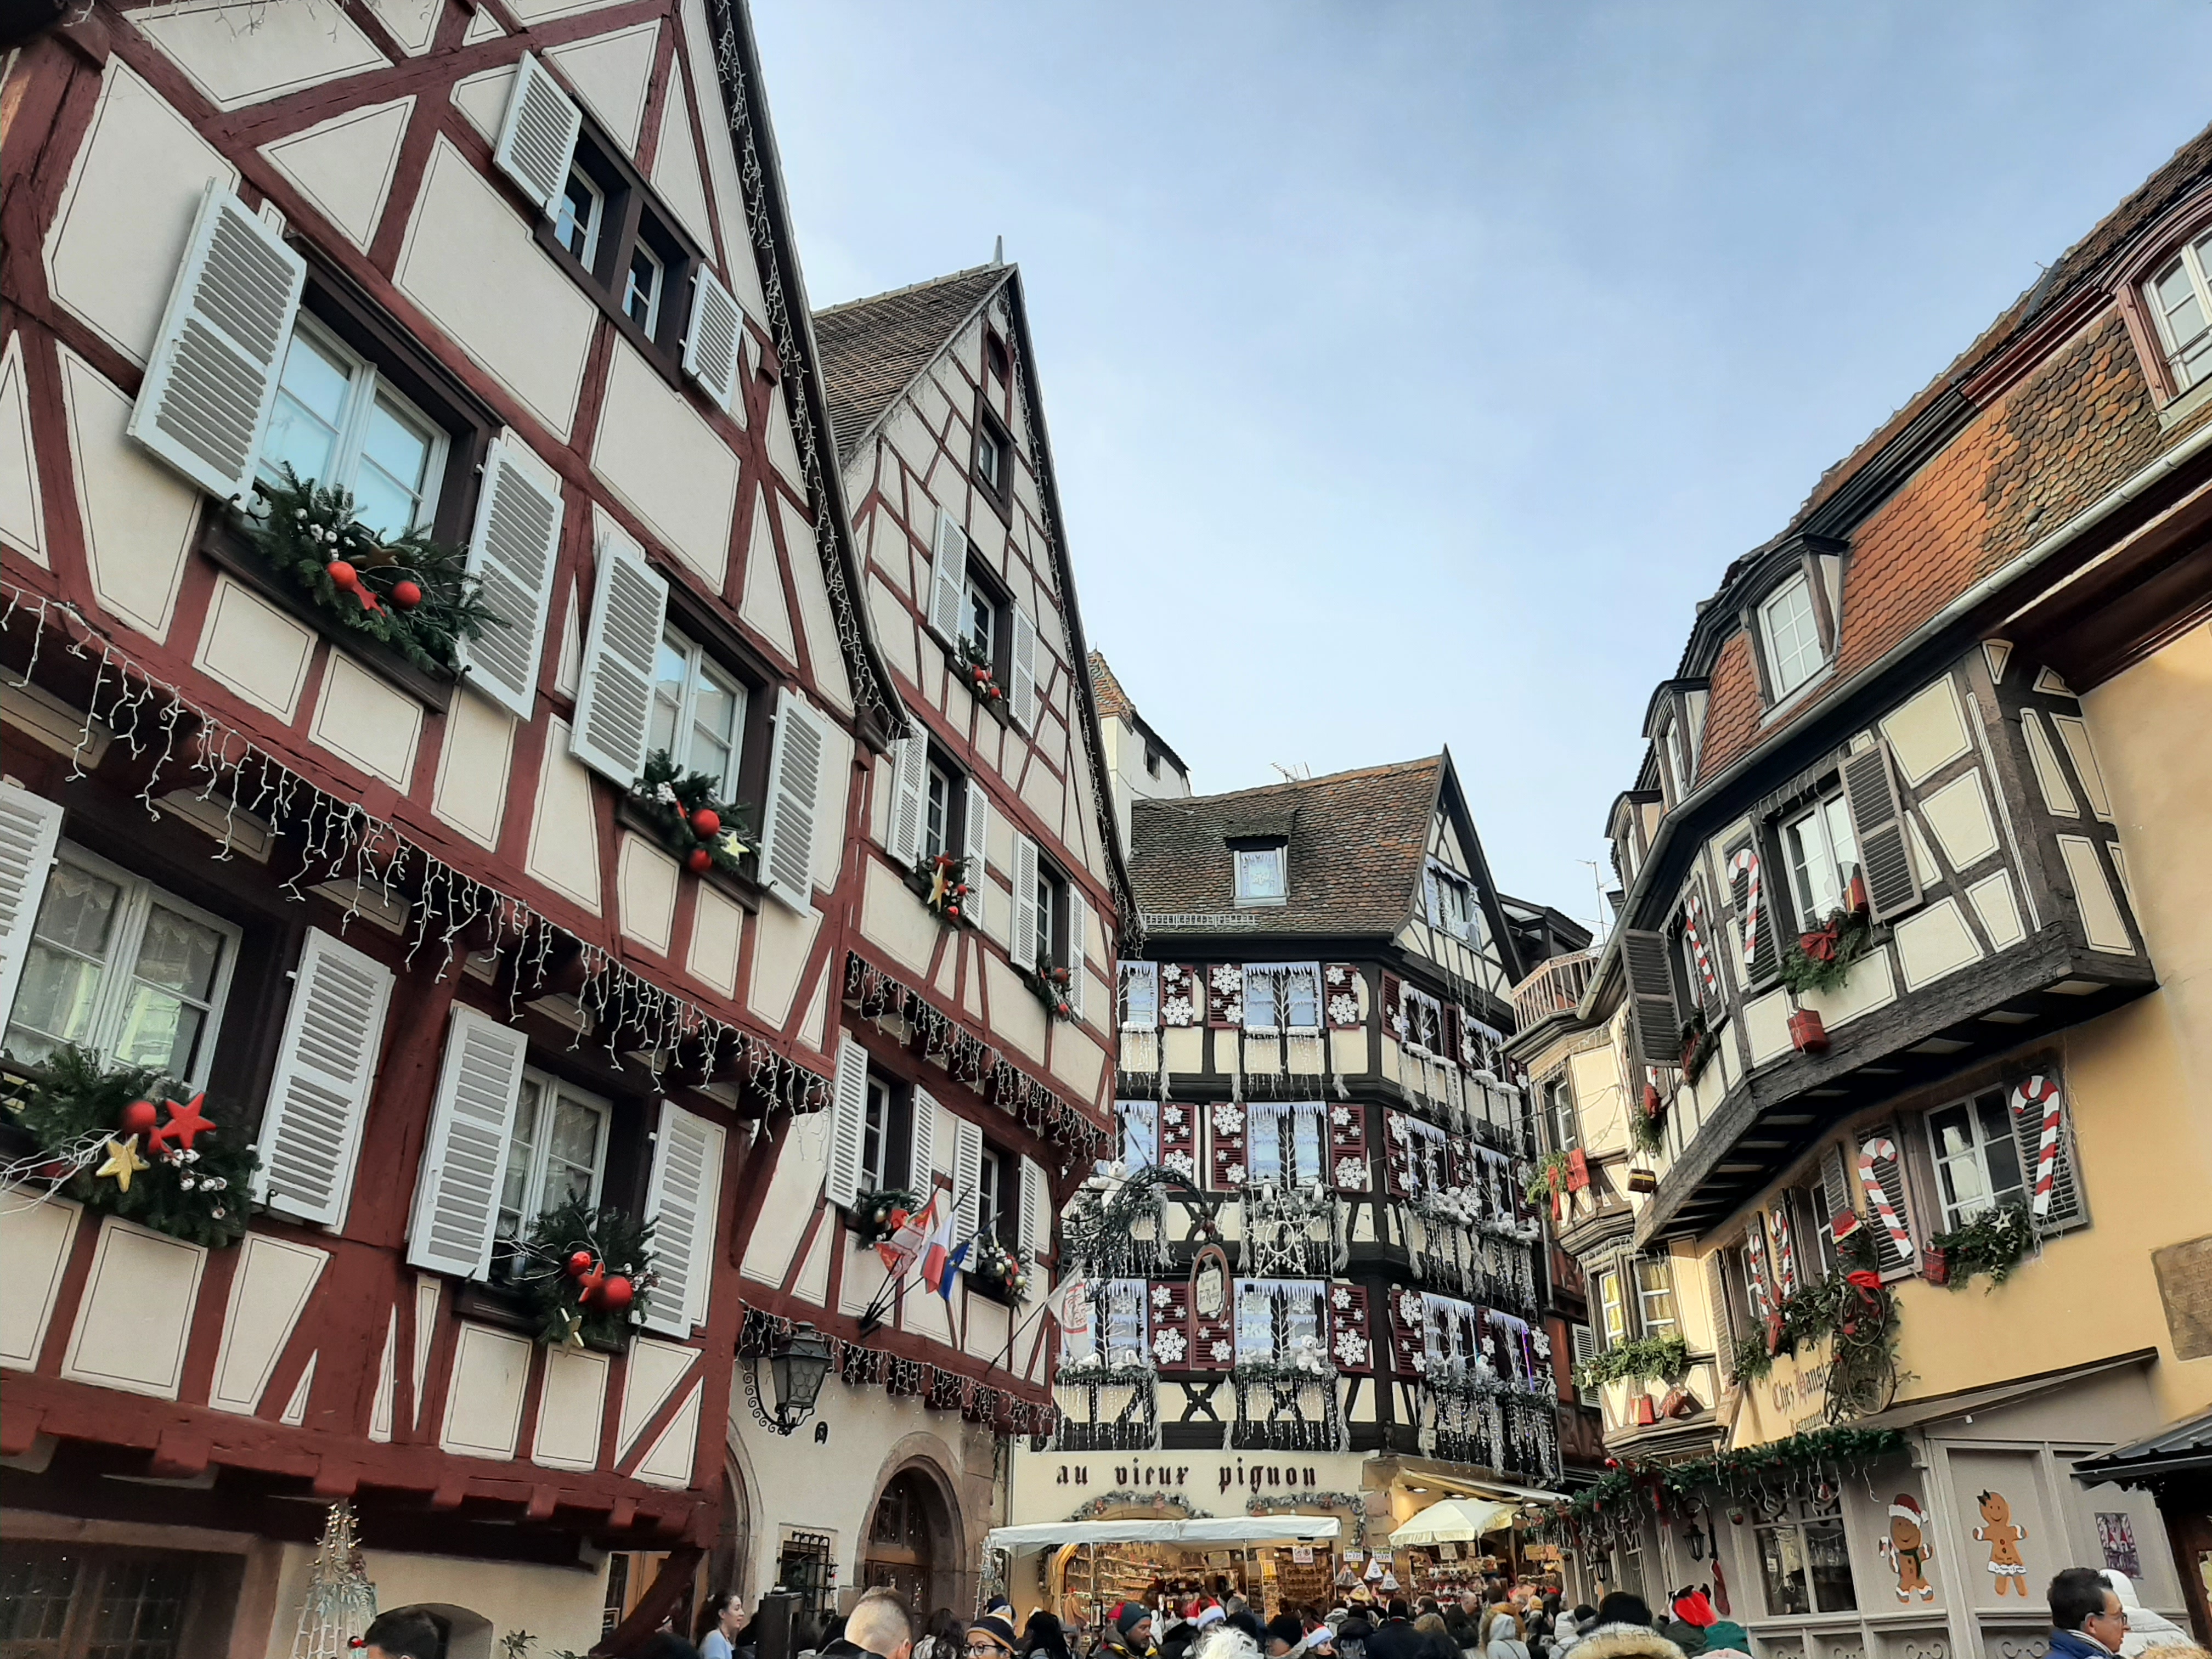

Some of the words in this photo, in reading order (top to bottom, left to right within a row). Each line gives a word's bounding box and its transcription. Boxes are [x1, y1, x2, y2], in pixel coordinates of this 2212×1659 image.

[1773, 1379, 1795, 1416] Chez
[1793, 1362, 1827, 1405] Hansi
[1057, 1465, 1088, 1485] au
[1114, 1457, 1189, 1485] vieux
[1218, 1456, 1316, 1495] pignon
